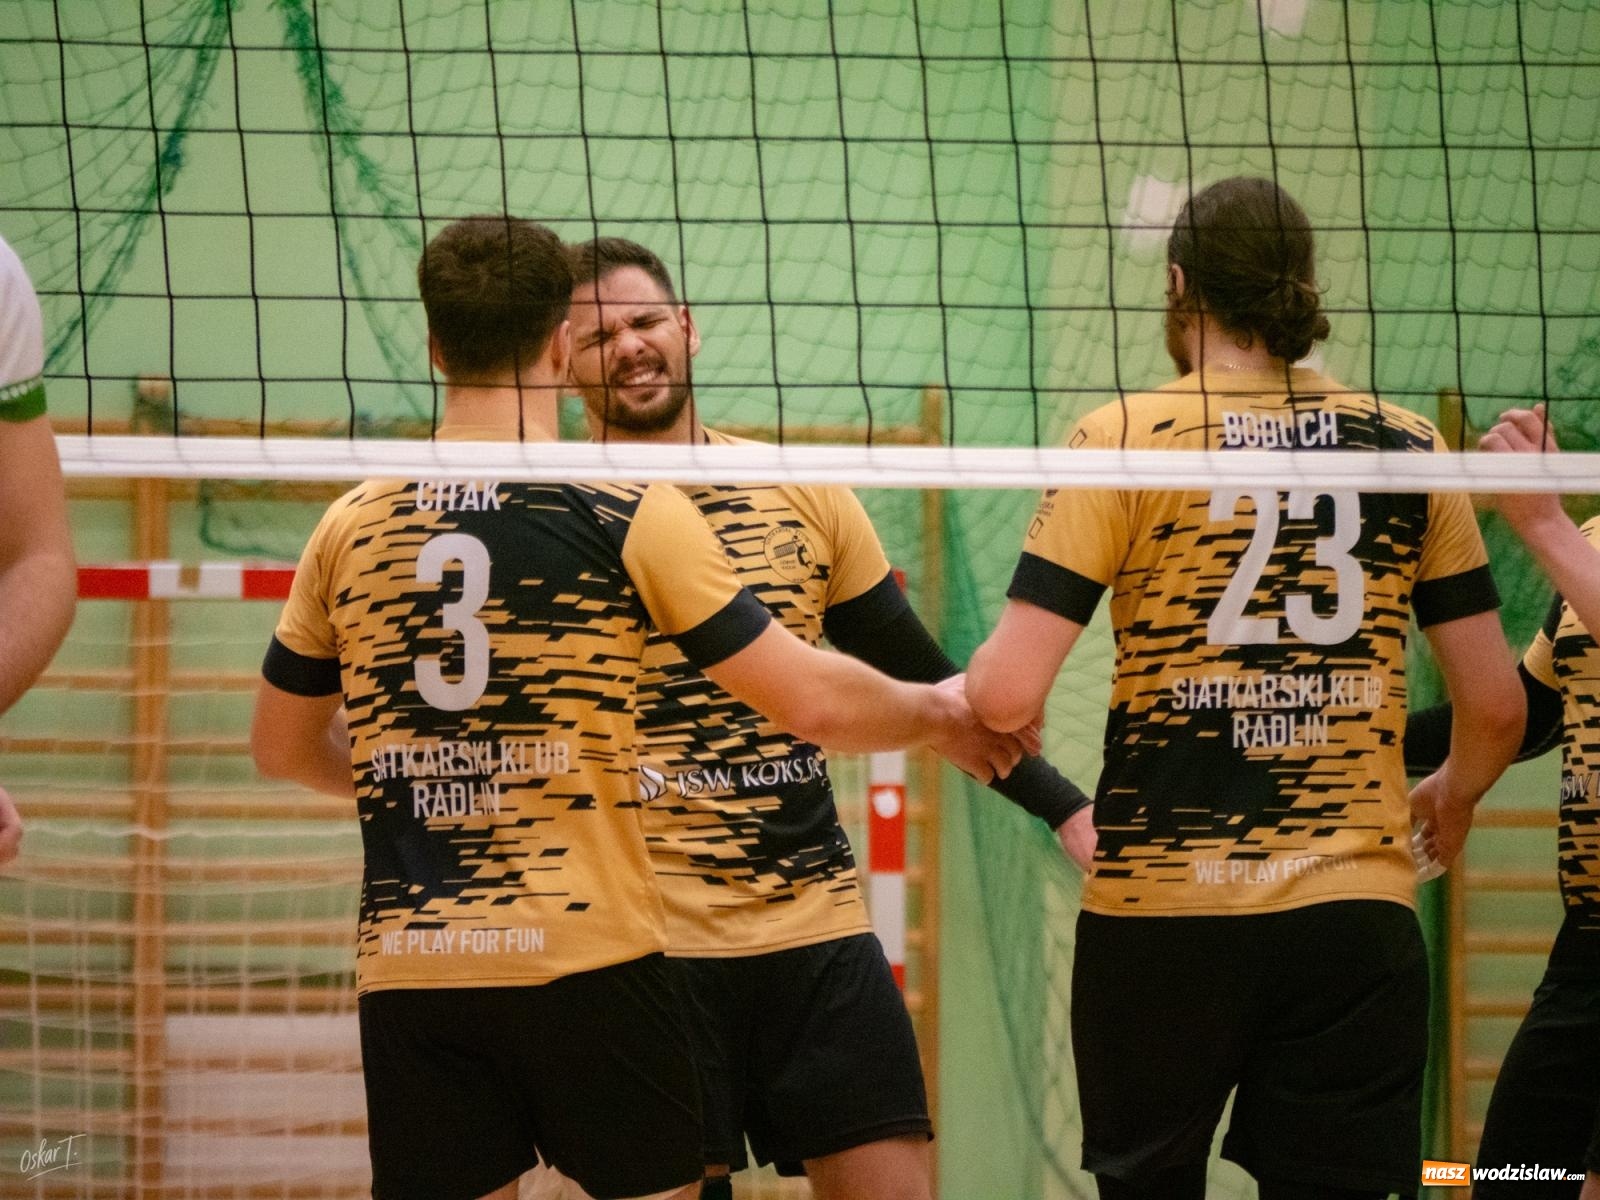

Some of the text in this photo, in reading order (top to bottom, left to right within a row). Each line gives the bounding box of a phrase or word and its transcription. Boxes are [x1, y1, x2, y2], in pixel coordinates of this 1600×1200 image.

[1206, 488, 1365, 645] 23
[414, 533, 490, 711] 3
[1171, 674, 1382, 710] SIATKARSKI KLUB
[1232, 714, 1329, 748] RADLIN
[501, 741, 569, 775] KLUB
[677, 765, 732, 797] JSW
[741, 758, 803, 788] KOKS
[1195, 859, 1226, 885] WE
[1230, 860, 1277, 884] PLAY
[381, 927, 545, 956] WE PLAY FOR FUN
